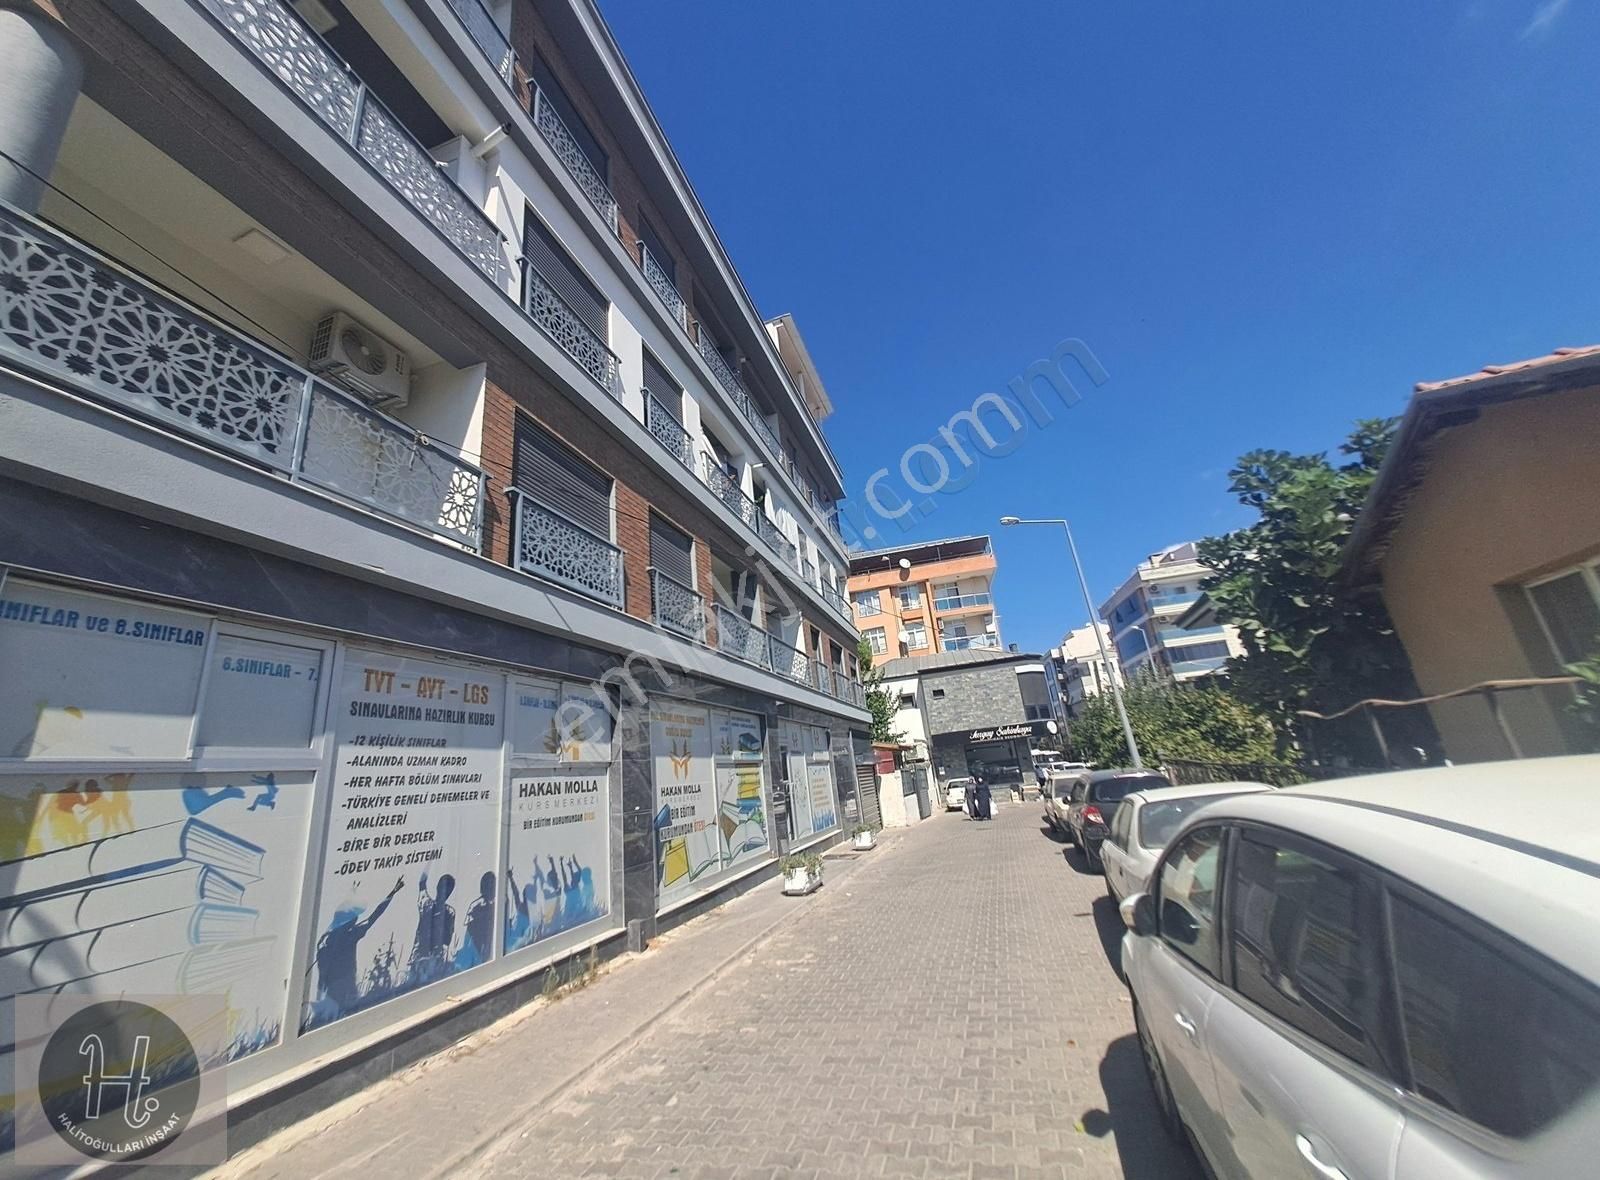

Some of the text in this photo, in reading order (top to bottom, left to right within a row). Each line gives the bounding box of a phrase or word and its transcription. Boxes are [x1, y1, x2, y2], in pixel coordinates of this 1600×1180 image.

[364, 668, 396, 694] TYT
[417, 676, 446, 700] AYT
[463, 682, 489, 705] LGS
[425, 708, 466, 724] HAZIRLIK
[468, 712, 495, 726] KURSU
[368, 733, 405, 749] KİŞİLİK
[406, 737, 447, 748] SINIFLAR
[407, 756, 438, 766] UZMAN
[440, 756, 467, 766] KADRO
[374, 775, 405, 787] HAFTA
[408, 772, 439, 786] BÖLÜM
[441, 773, 482, 785] SINAVLARI
[519, 779, 598, 798] HAKAN MOLLA
[394, 792, 429, 806] GENELİ
[430, 790, 478, 804] DENEMELER
[480, 790, 490, 800] VE
[660, 783, 701, 797] HAKAN MOLLA
[346, 811, 408, 830] ANALİZLERİ
[373, 833, 391, 849] BİR
[394, 831, 435, 846] DERSLER
[374, 853, 403, 870] TAKİP
[405, 846, 443, 865] SİSTEMİ
